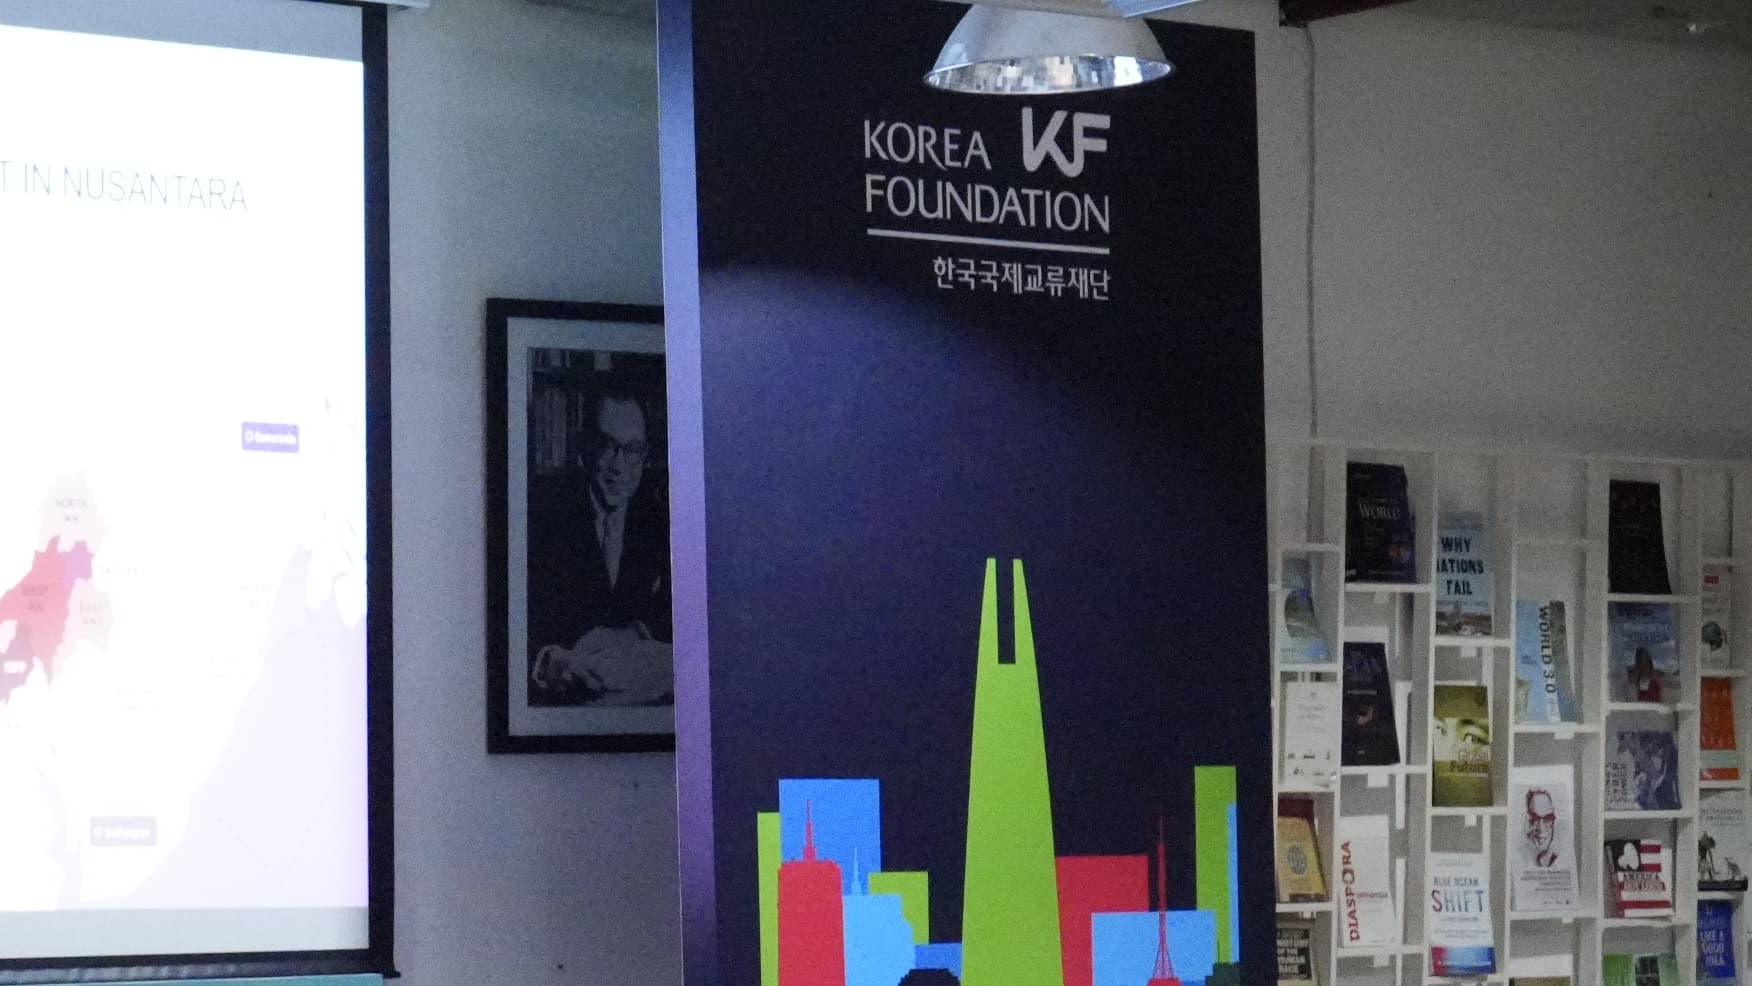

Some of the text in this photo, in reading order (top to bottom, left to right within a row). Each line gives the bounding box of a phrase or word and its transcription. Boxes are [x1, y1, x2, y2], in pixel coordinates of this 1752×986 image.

[864, 106, 1111, 178] KOREA KF
[24, 161, 51, 197] IN
[62, 165, 248, 212] NUSANTARA
[864, 172, 1111, 235] FOUNDATION
[933, 255, 1112, 301] 한국국제교류재단
[1441, 537, 1472, 553] WHY
[1446, 580, 1473, 596] FAIL
[1538, 605, 1554, 670] WORLD
[1341, 840, 1361, 942] DIASPORA
[1431, 889, 1485, 913] SHIFT
